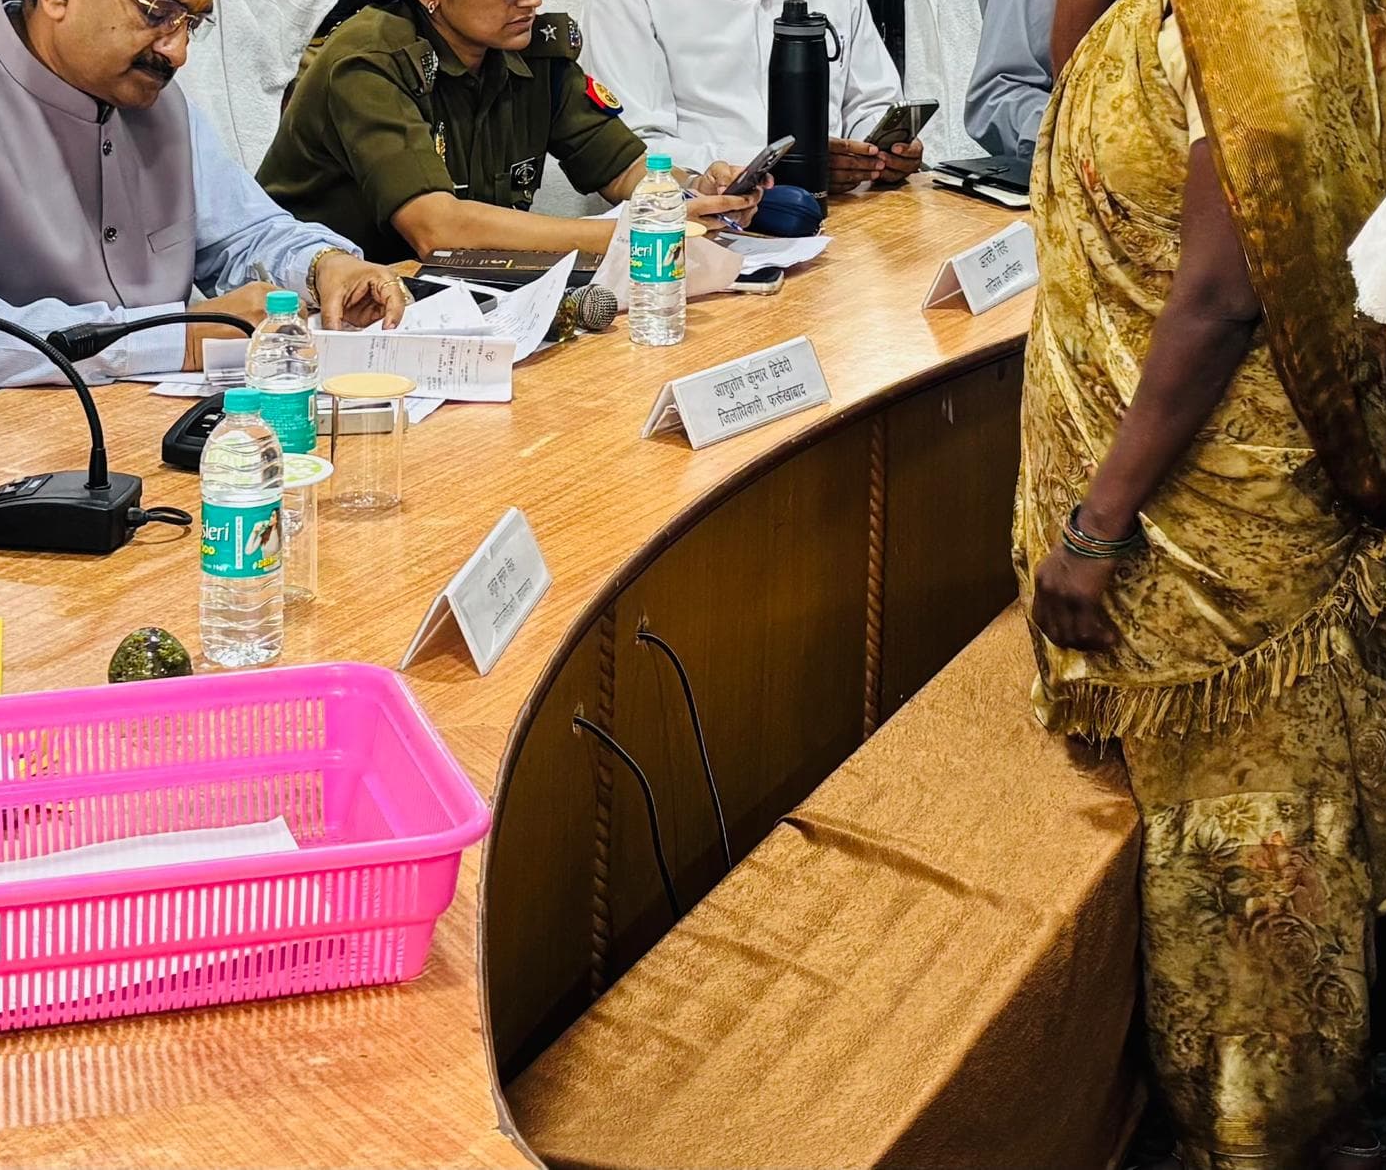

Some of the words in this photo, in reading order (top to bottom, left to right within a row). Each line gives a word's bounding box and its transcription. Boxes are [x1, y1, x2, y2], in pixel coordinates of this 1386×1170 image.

[713, 373, 746, 399] आशुतोष
[744, 367, 769, 390] कुमार
[769, 355, 793, 379] द्विवेदी
